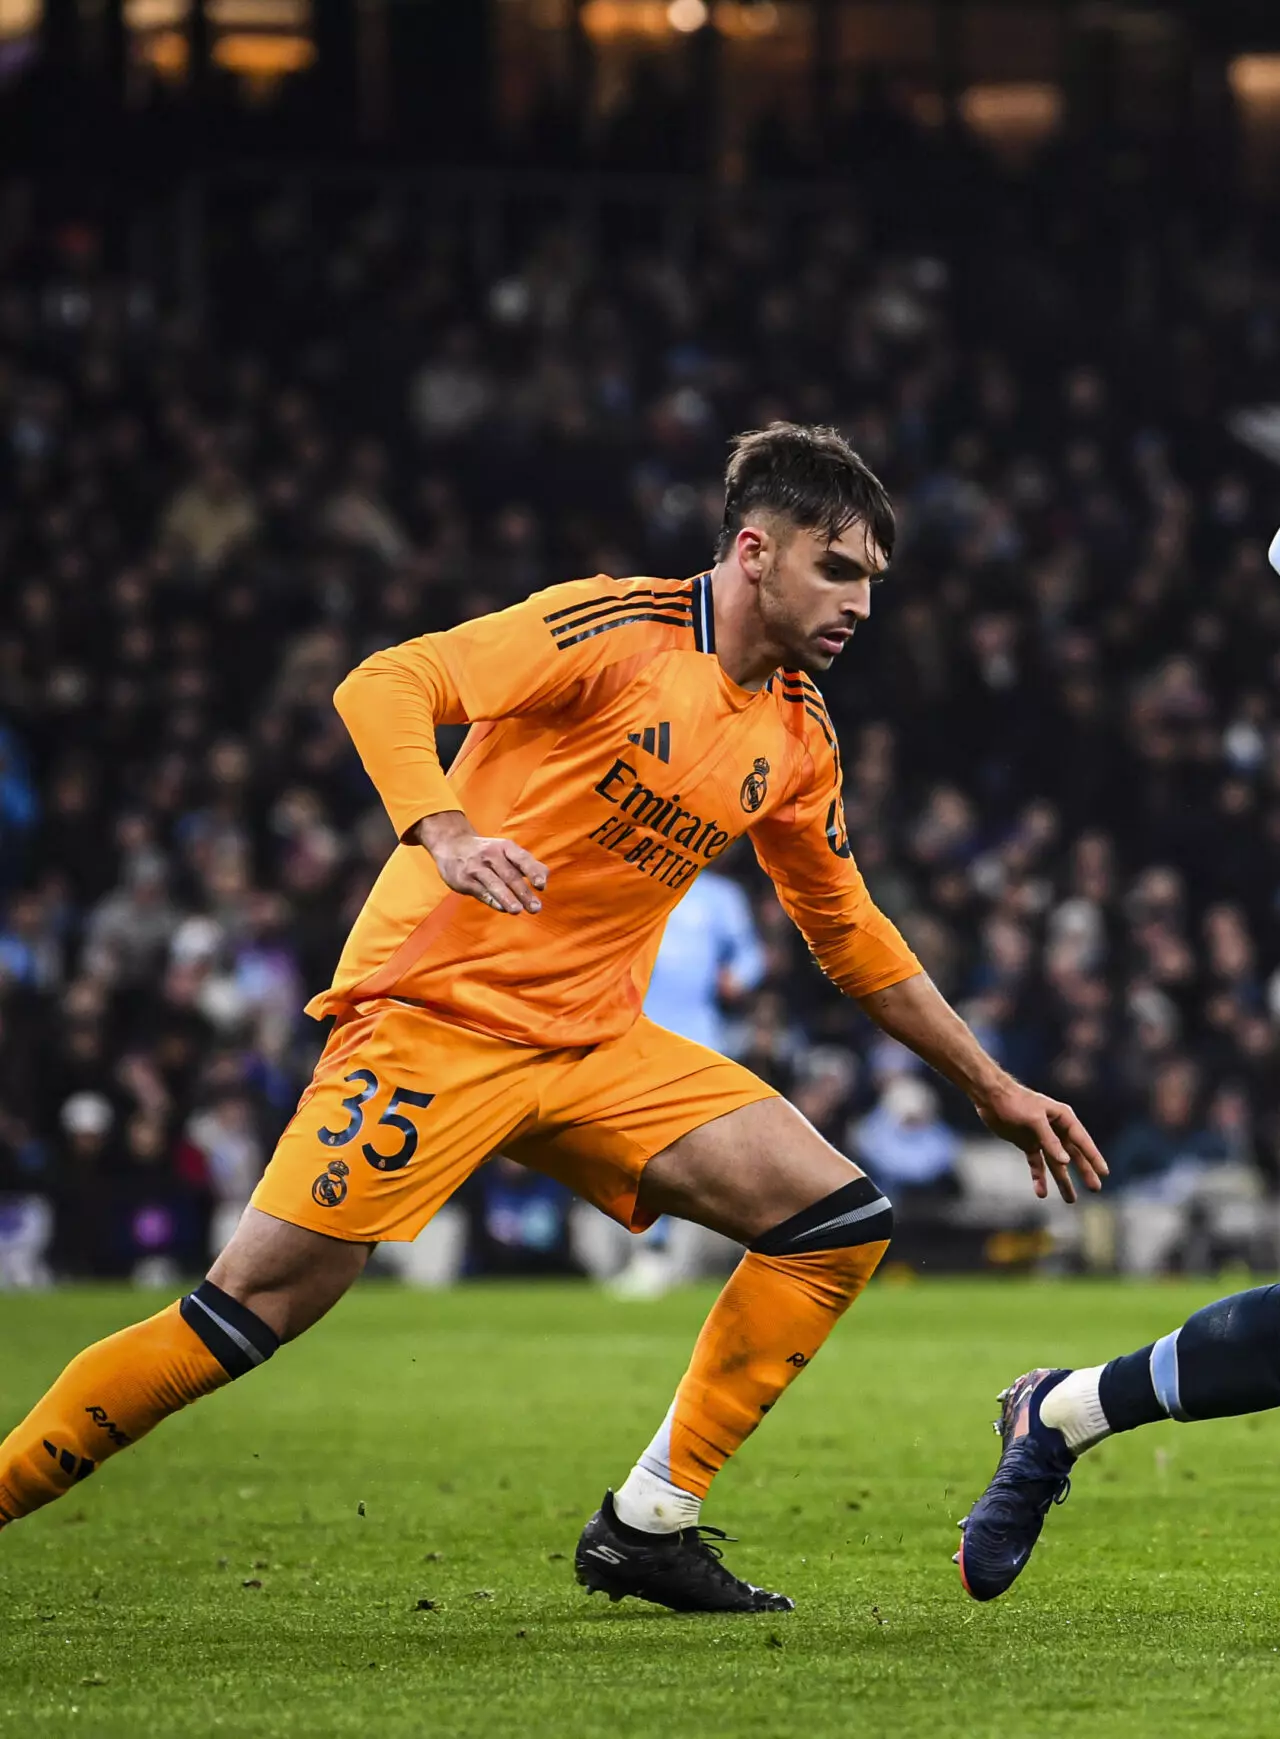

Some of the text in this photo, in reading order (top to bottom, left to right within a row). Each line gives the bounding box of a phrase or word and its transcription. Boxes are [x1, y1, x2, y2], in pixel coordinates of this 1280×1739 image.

[589, 816, 699, 890] FLY BETTER
[594, 758, 737, 859] Emirate
[317, 1069, 436, 1172] 35
